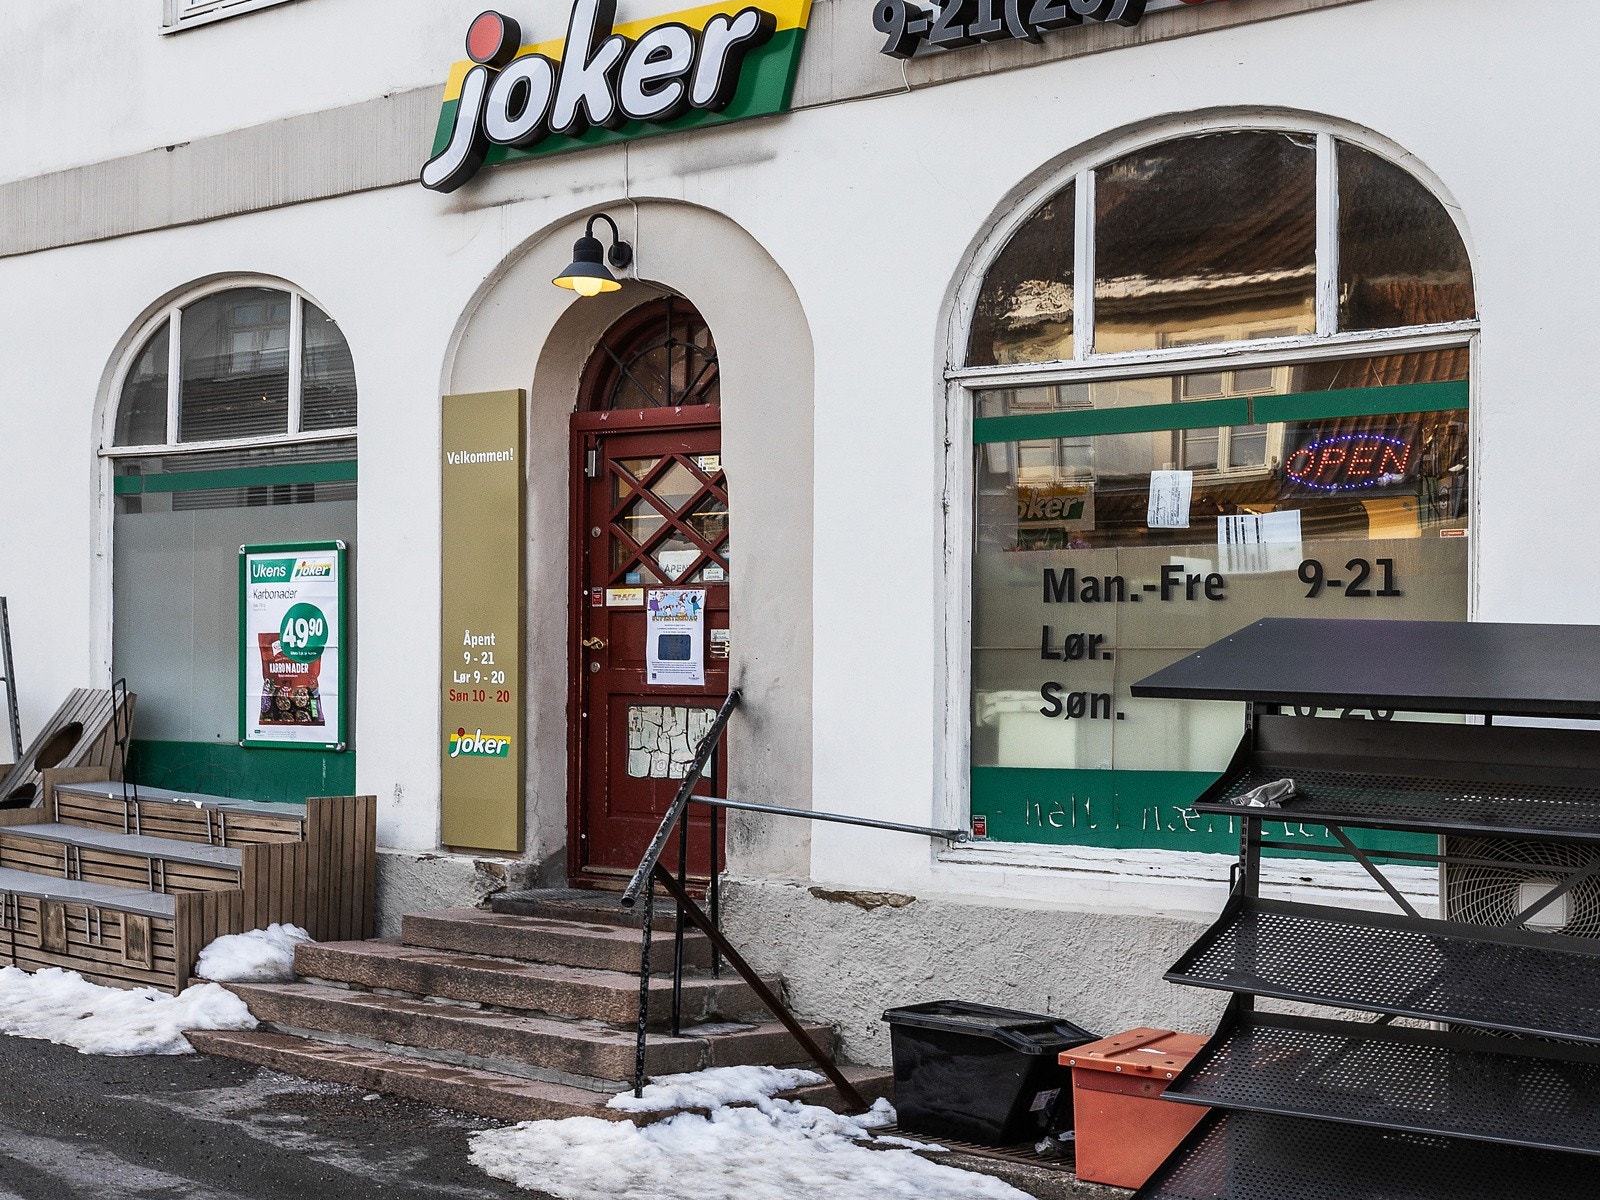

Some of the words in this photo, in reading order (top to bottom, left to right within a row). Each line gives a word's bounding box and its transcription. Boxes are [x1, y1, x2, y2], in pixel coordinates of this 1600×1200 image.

[446, 447, 514, 465] Velkommen!
[1286, 443, 1411, 477] OPEN
[1018, 487, 1079, 519] oker
[252, 563, 287, 578] Ukens
[295, 560, 329, 579] joker
[1297, 558, 1401, 599] 9-21
[253, 587, 298, 600] Karbonader
[463, 629, 496, 648] Åpent
[1040, 625, 1113, 662] Lør.
[463, 651, 471, 665] 9
[480, 651, 495, 665] 21
[269, 662, 309, 674] KARBONADER
[453, 670, 471, 684] Lør
[473, 670, 481, 684] 9
[490, 670, 505, 684] 20
[449, 689, 469, 702] Søn
[472, 689, 486, 702] 10
[496, 689, 510, 703] 20
[1039, 681, 1126, 721] Søn.
[450, 727, 508, 759] joker
